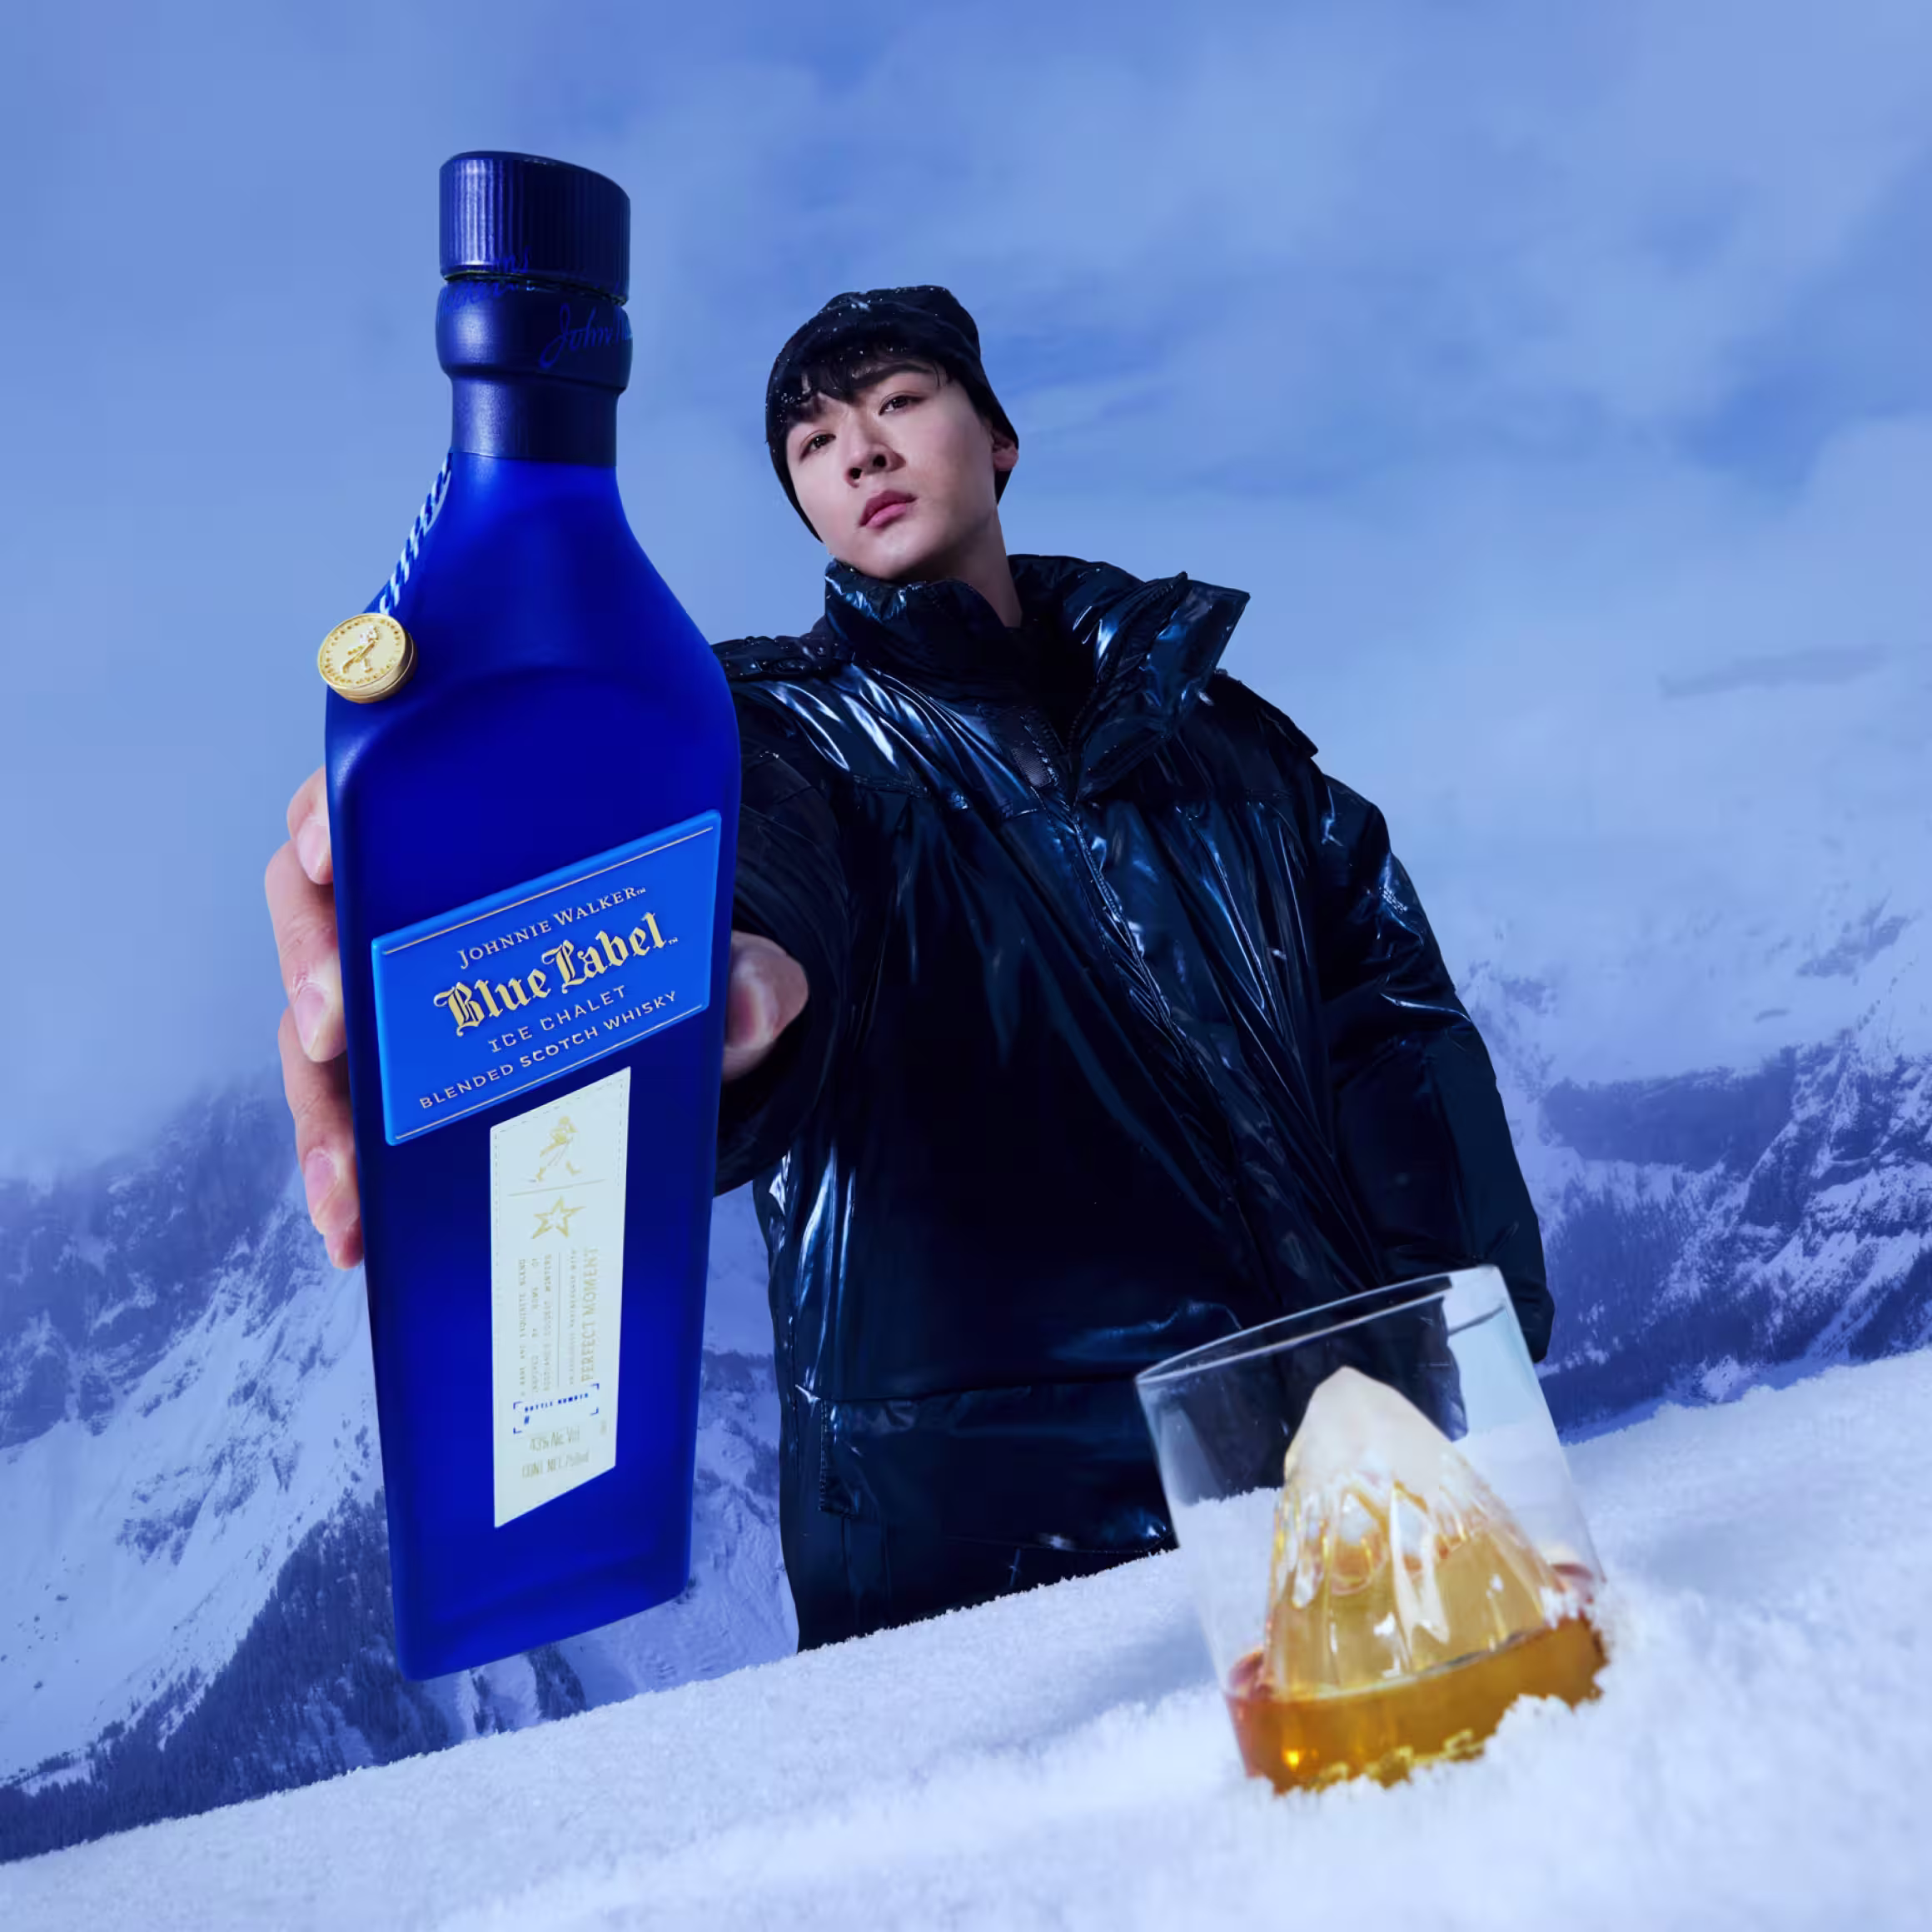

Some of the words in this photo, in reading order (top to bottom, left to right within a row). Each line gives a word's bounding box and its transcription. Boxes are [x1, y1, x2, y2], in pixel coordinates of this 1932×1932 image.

[457, 920, 552, 969] JOHNNIE
[433, 968, 551, 1037] Blue
[488, 1026, 533, 1053] ICE
[540, 984, 625, 1031] CHALET
[420, 1064, 514, 1109] BLENDED
[520, 1026, 599, 1068] SCOTCH
[603, 991, 676, 1030] WHISKY
[582, 1247, 598, 1316] MOMENT
[581, 1321, 595, 1382] PERFECT
